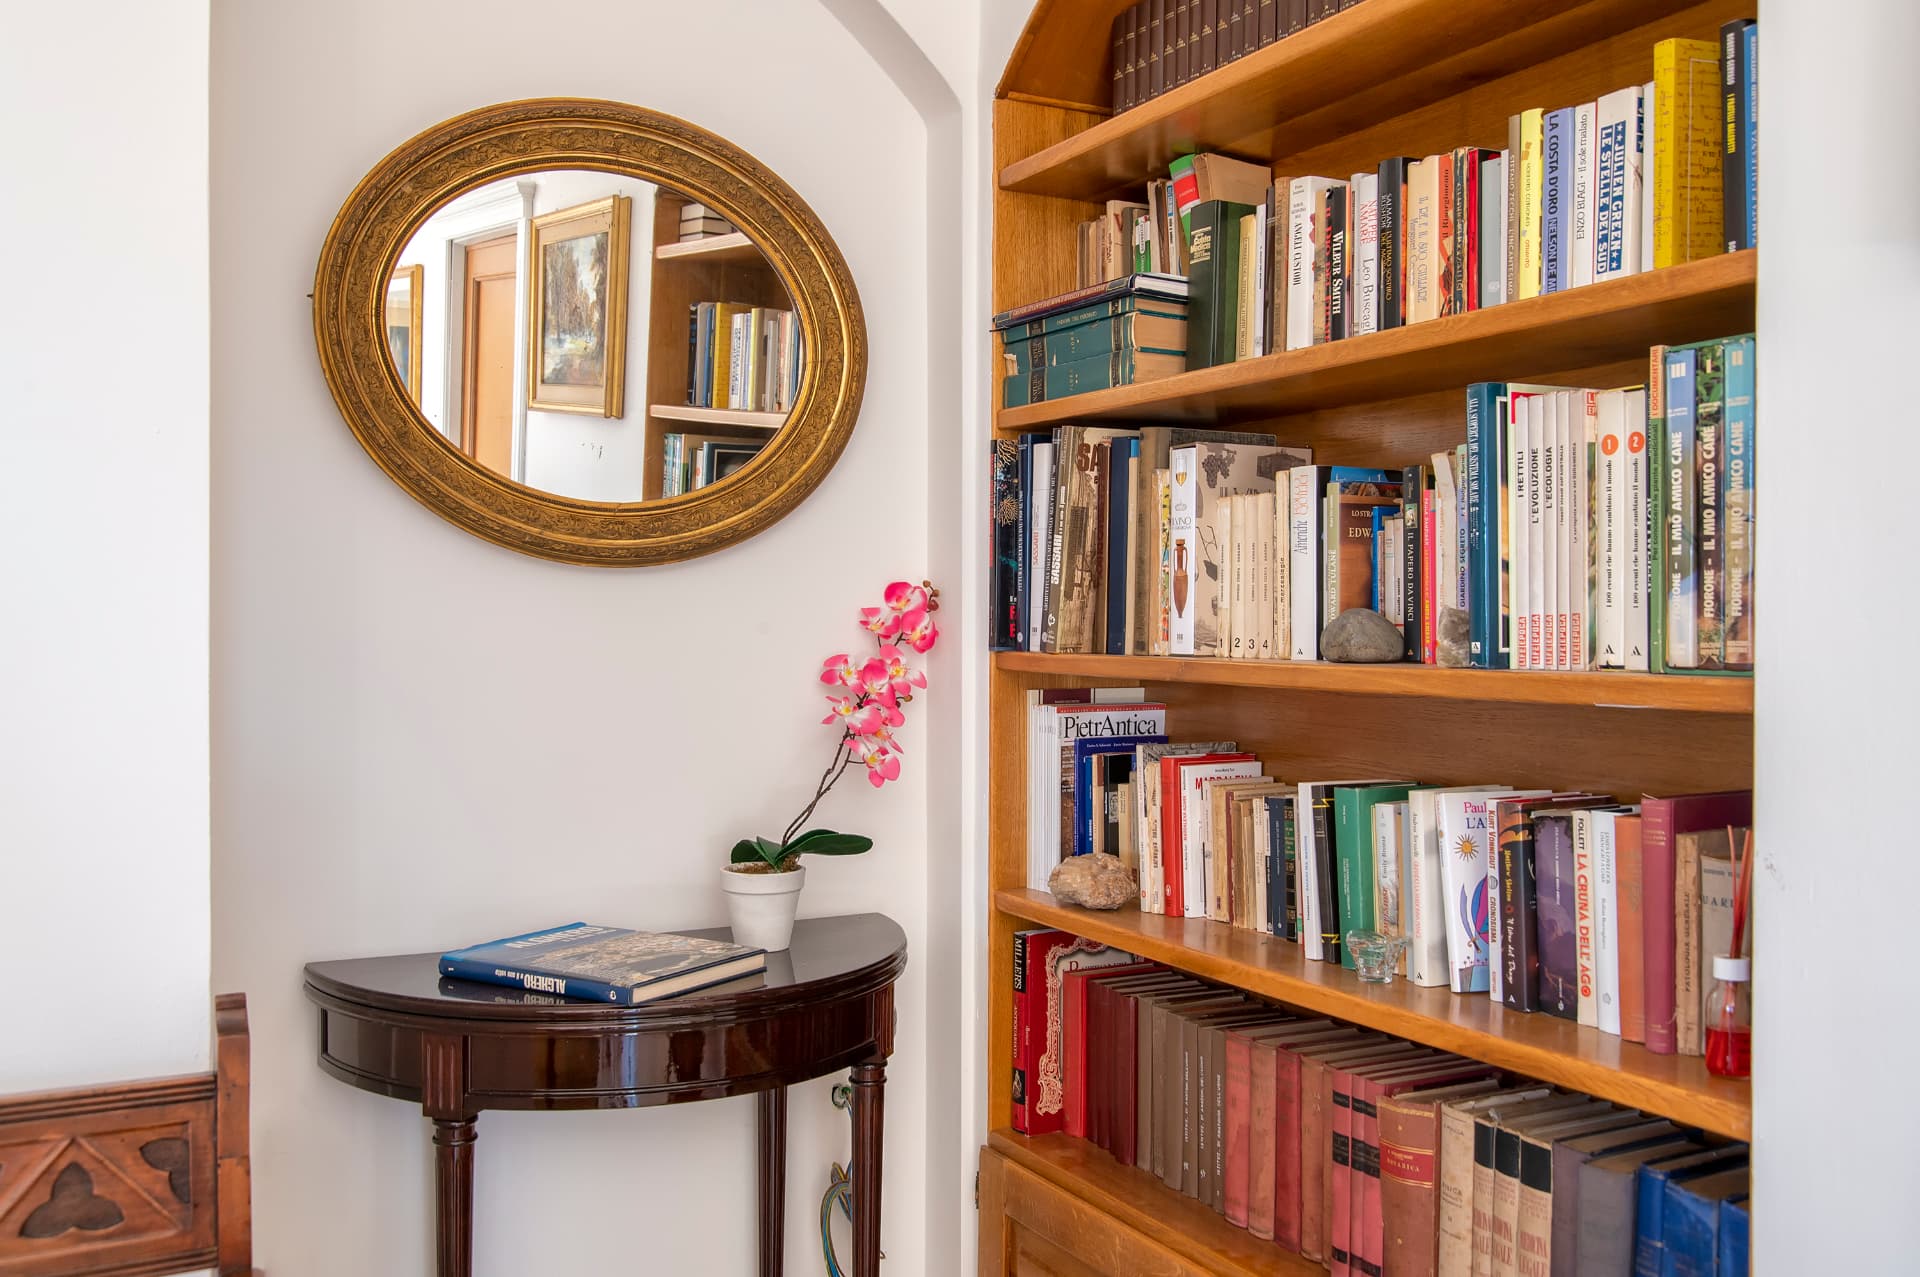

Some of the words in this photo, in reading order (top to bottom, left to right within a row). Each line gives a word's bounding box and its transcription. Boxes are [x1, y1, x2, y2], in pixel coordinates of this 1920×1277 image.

[1548, 114, 1559, 132] LA
[1579, 113, 1588, 146] malato
[1601, 128, 1612, 149] LE
[1548, 135, 1559, 174] COSTA
[1578, 149, 1587, 166] sole
[1599, 151, 1612, 206] STELLE
[1611, 143, 1624, 197] JULIEN
[1548, 177, 1559, 215] D'ORO
[1577, 182, 1586, 210] BIAGI
[1359, 203, 1368, 244] AMARE
[1368, 201, 1377, 224] NATI
[1577, 212, 1585, 240] ENZO
[1598, 211, 1610, 241] DEL
[1610, 201, 1623, 250] GREEN
[1293, 222, 1303, 249] ANGELI
[1368, 225, 1377, 242] PER
[1408, 217, 1418, 250] Margaret
[1548, 218, 1557, 261] NELSON
[1332, 230, 1343, 275] WILBUR
[1417, 241, 1429, 261] SUO
[1597, 241, 1609, 273] SUD
[1292, 252, 1302, 286] CUSTODI
[1362, 258, 1374, 281] Leo
[1548, 262, 1557, 277] DE
[1332, 278, 1343, 315] SMITH
[1548, 278, 1557, 293] MI
[1360, 284, 1375, 334] Buscagl
[1469, 398, 1479, 413] ALLA
[1469, 413, 1479, 442] SCOPERTA
[1730, 420, 1744, 456] CANE
[1469, 442, 1479, 454] DEL
[1671, 431, 1683, 465] CANE
[1703, 425, 1716, 459] CANE
[1469, 454, 1479, 479] SISTEMA
[1545, 446, 1553, 509] L'ECOLOGIA
[1605, 459, 1613, 484] mondo
[1631, 458, 1639, 483] mondo
[1469, 479, 1479, 504] SOLARE
[1531, 447, 1539, 524] L'EVOLUZIONE
[1671, 468, 1683, 511] AMICO
[1703, 461, 1716, 506] AMICO
[1730, 459, 1744, 505] AMICO
[1605, 492, 1613, 527] cambiato
[1631, 491, 1639, 526] cambiato
[1652, 494, 1658, 502] le
[1349, 527, 1373, 538] EDW
[1671, 514, 1683, 542] MIO
[1703, 508, 1716, 536] MIO
[1730, 507, 1744, 536] MIO
[1407, 532, 1414, 541] IL
[1605, 528, 1613, 552] hanno
[1631, 528, 1639, 552] hanno
[1671, 543, 1683, 556] IL
[1703, 538, 1716, 550] IL
[1730, 538, 1744, 549] IL
[1051, 534, 1063, 585] SASSARI
[1327, 549, 1336, 583] TULANE
[1605, 553, 1613, 568] che
[1631, 553, 1639, 568] che
[1407, 582, 1414, 595] DA
[1605, 569, 1613, 591] eventi
[1631, 568, 1639, 591] eventi
[1703, 569, 1716, 618] FIORONE
[1730, 567, 1744, 617] FIORONE
[1518, 617, 1526, 645] EPOCA
[1532, 613, 1540, 644] EPOCA
[1545, 614, 1553, 645] EPOCA
[1559, 613, 1567, 644] EPOCA
[1572, 612, 1581, 644] EPOCA
[1234, 637, 1241, 648] 2
[1248, 638, 1255, 650] 3
[1262, 639, 1268, 649] 4
[1532, 645, 1540, 665] LIFE
[1545, 646, 1553, 666] LIFE
[1559, 646, 1567, 666] LIFE
[1572, 645, 1581, 665] LIFE
[1518, 648, 1526, 666] LIFE
[1063, 714, 1158, 739] PietrAntica
[1463, 801, 1487, 814] Paul
[1488, 809, 1496, 829] KURT
[1466, 817, 1488, 829] L'A
[1576, 817, 1585, 850] FOLLETT
[1488, 831, 1496, 871] VONNEGUT
[1504, 850, 1512, 877] Matthew
[1576, 853, 1588, 872] LA
[1577, 874, 1589, 921] CRUNA
[1578, 924, 1590, 961] DELL'
[494, 969, 506, 977] volto
[1014, 937, 1024, 989] MILLER'S
[523, 973, 566, 994] ALGHERO
[1580, 964, 1592, 998] AGO
